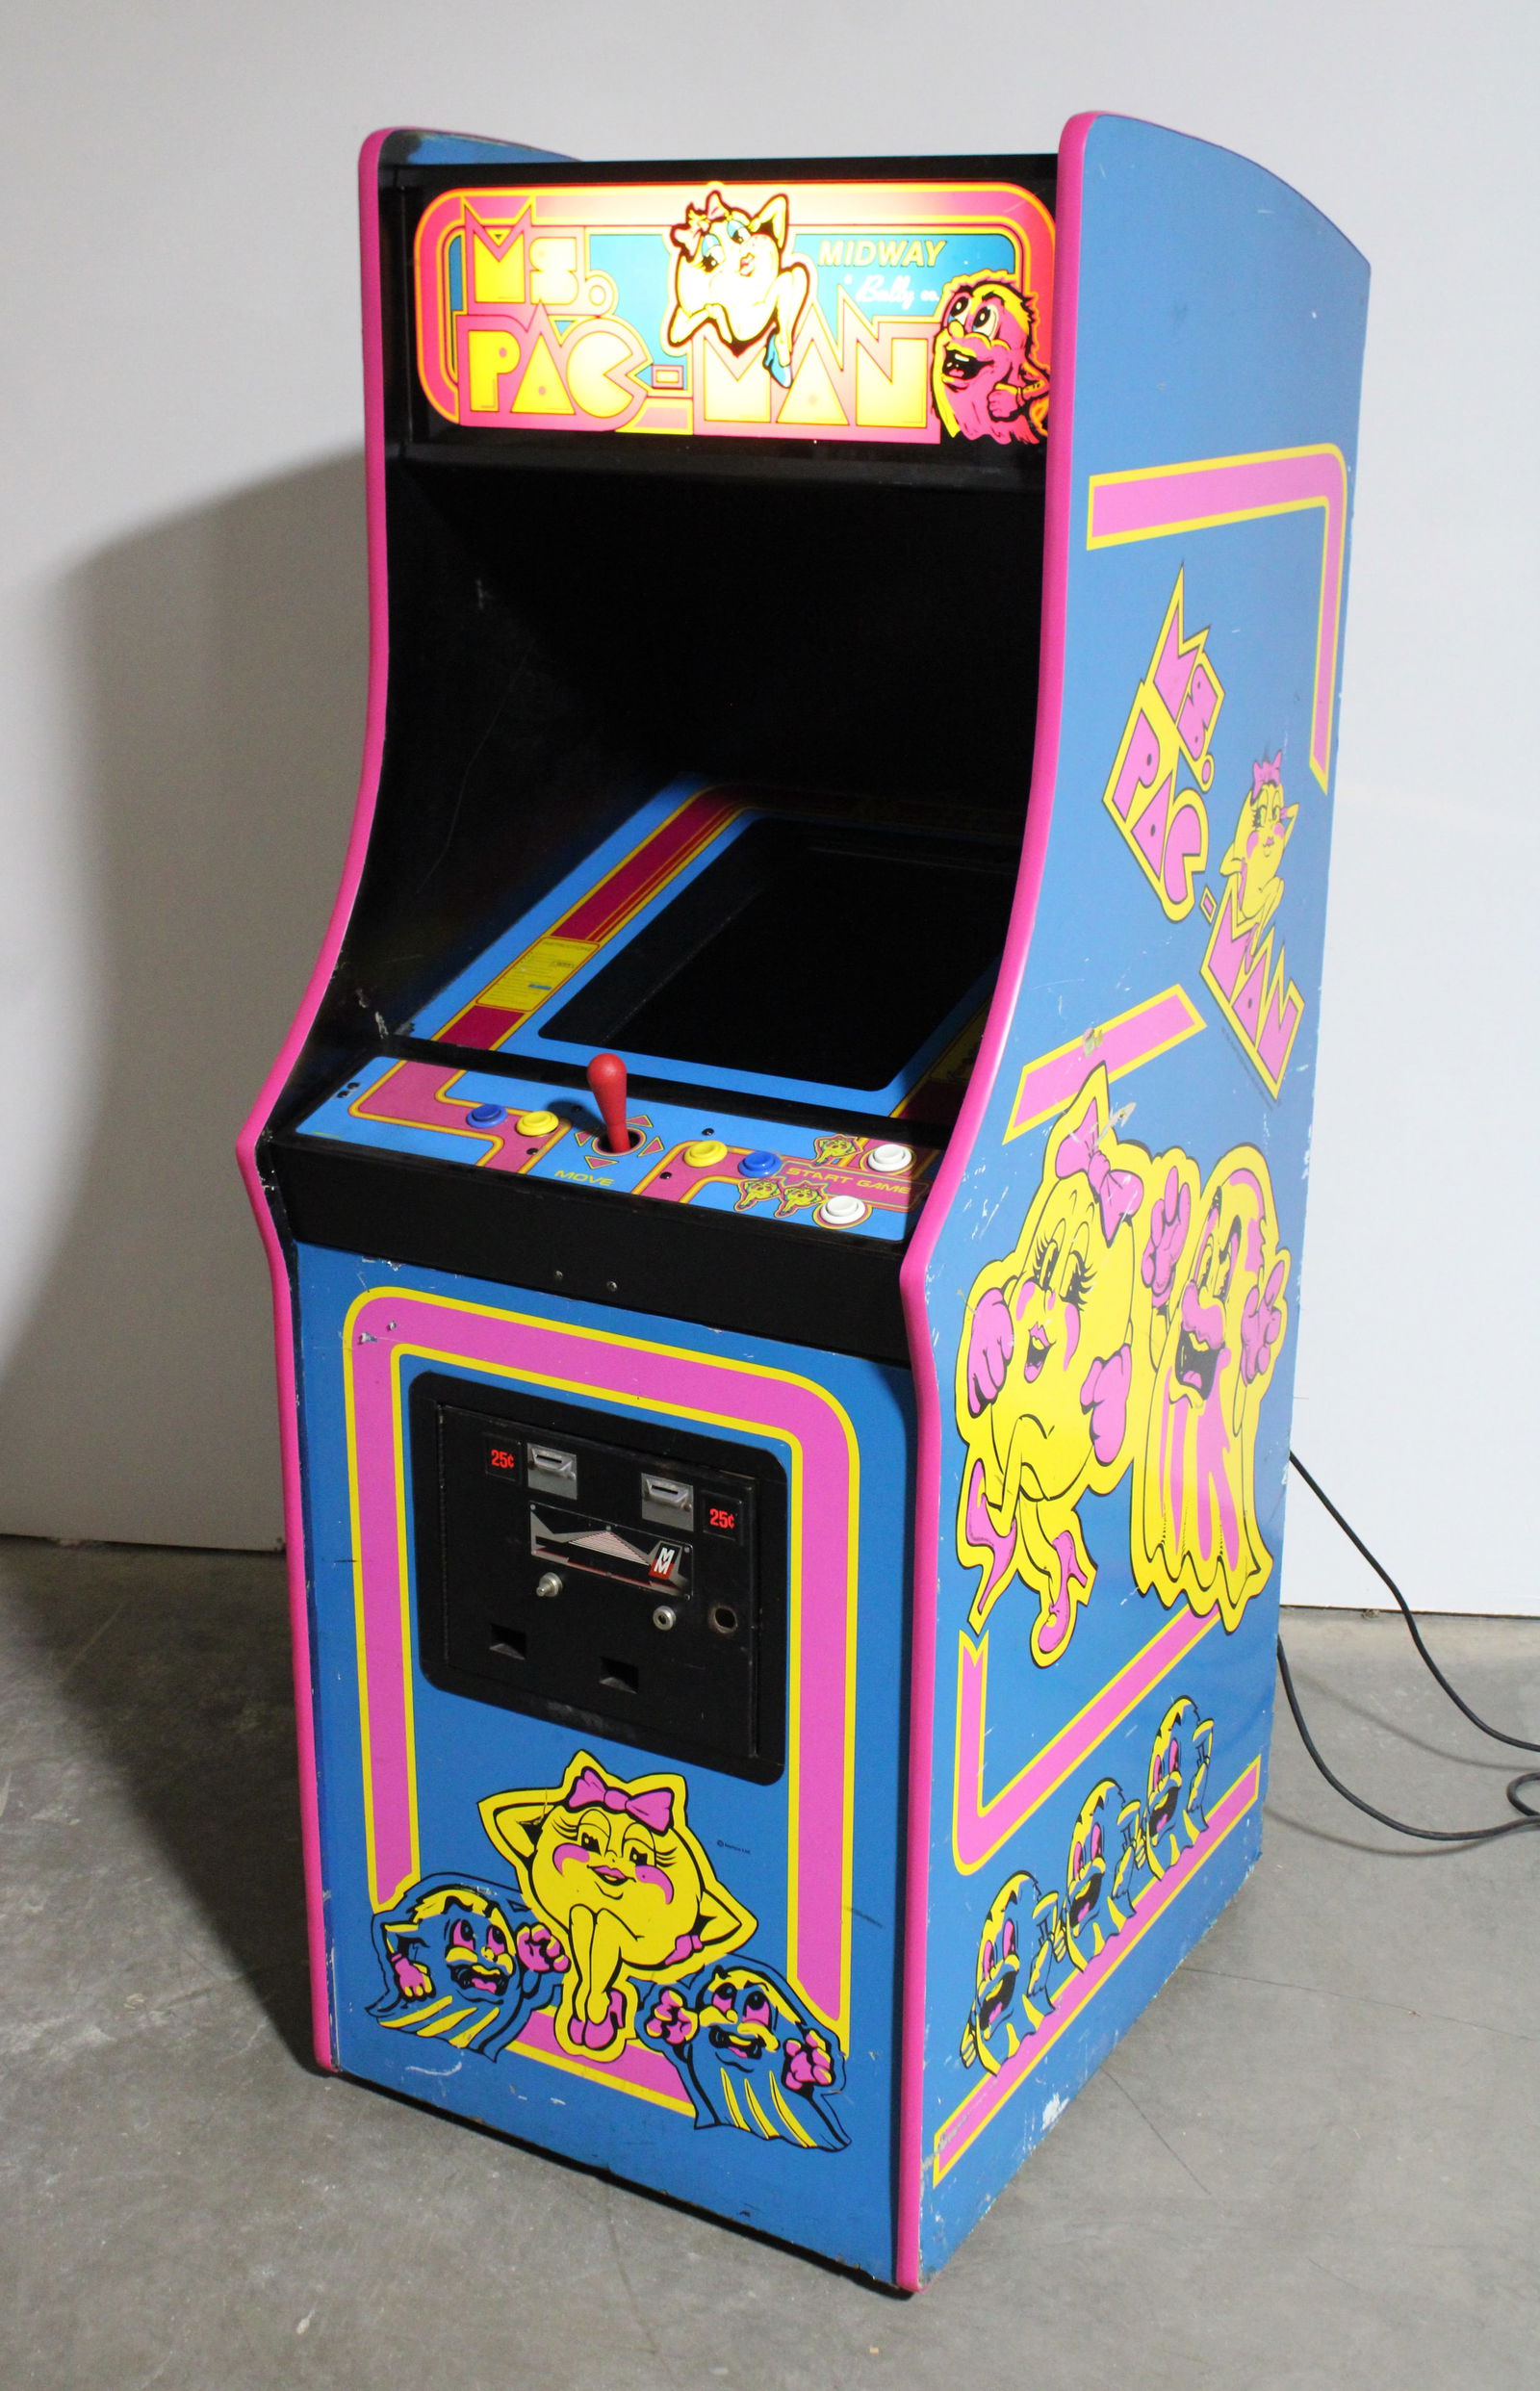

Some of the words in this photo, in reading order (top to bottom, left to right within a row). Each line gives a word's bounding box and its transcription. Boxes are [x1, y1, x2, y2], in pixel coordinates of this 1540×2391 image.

[818, 240, 947, 268] MIDWAY
[856, 274, 915, 310] Bally
[554, 1170, 615, 1187] MOVE
[785, 1168, 854, 1184] START
[857, 1179, 912, 1195] GAME
[491, 1449, 515, 1470] 25¢
[709, 1508, 735, 1530] 25¢
